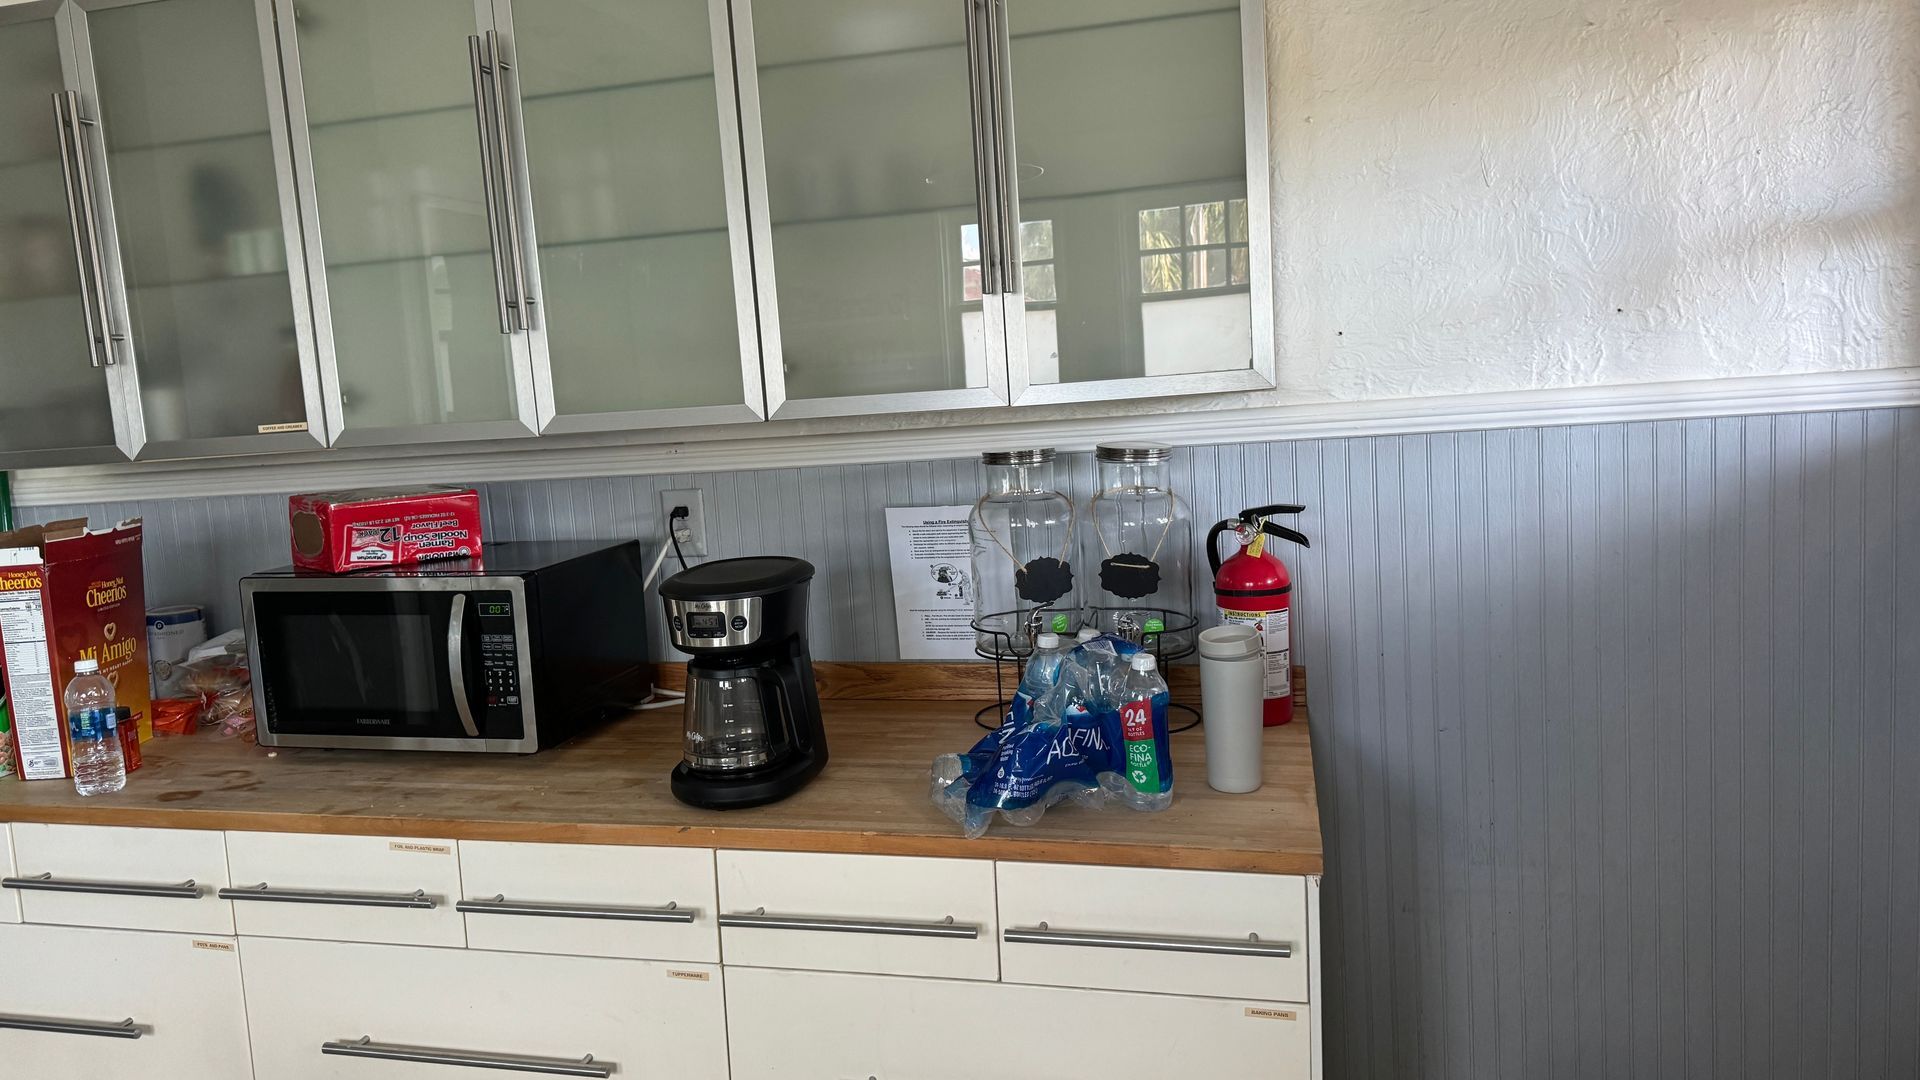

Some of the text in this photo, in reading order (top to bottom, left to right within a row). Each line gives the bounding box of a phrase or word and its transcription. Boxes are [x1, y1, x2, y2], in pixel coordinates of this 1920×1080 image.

[380, 527, 400, 543] 12
[403, 530, 468, 541] Noodle Soup
[418, 540, 454, 548] Ramen
[0, 576, 42, 590] heerios
[86, 585, 127, 608] Cheerios
[80, 637, 137, 664] Mi Amigo
[1125, 709, 1146, 727] 24
[1129, 744, 1151, 752] ECO-
[1129, 753, 1152, 762] FINA
